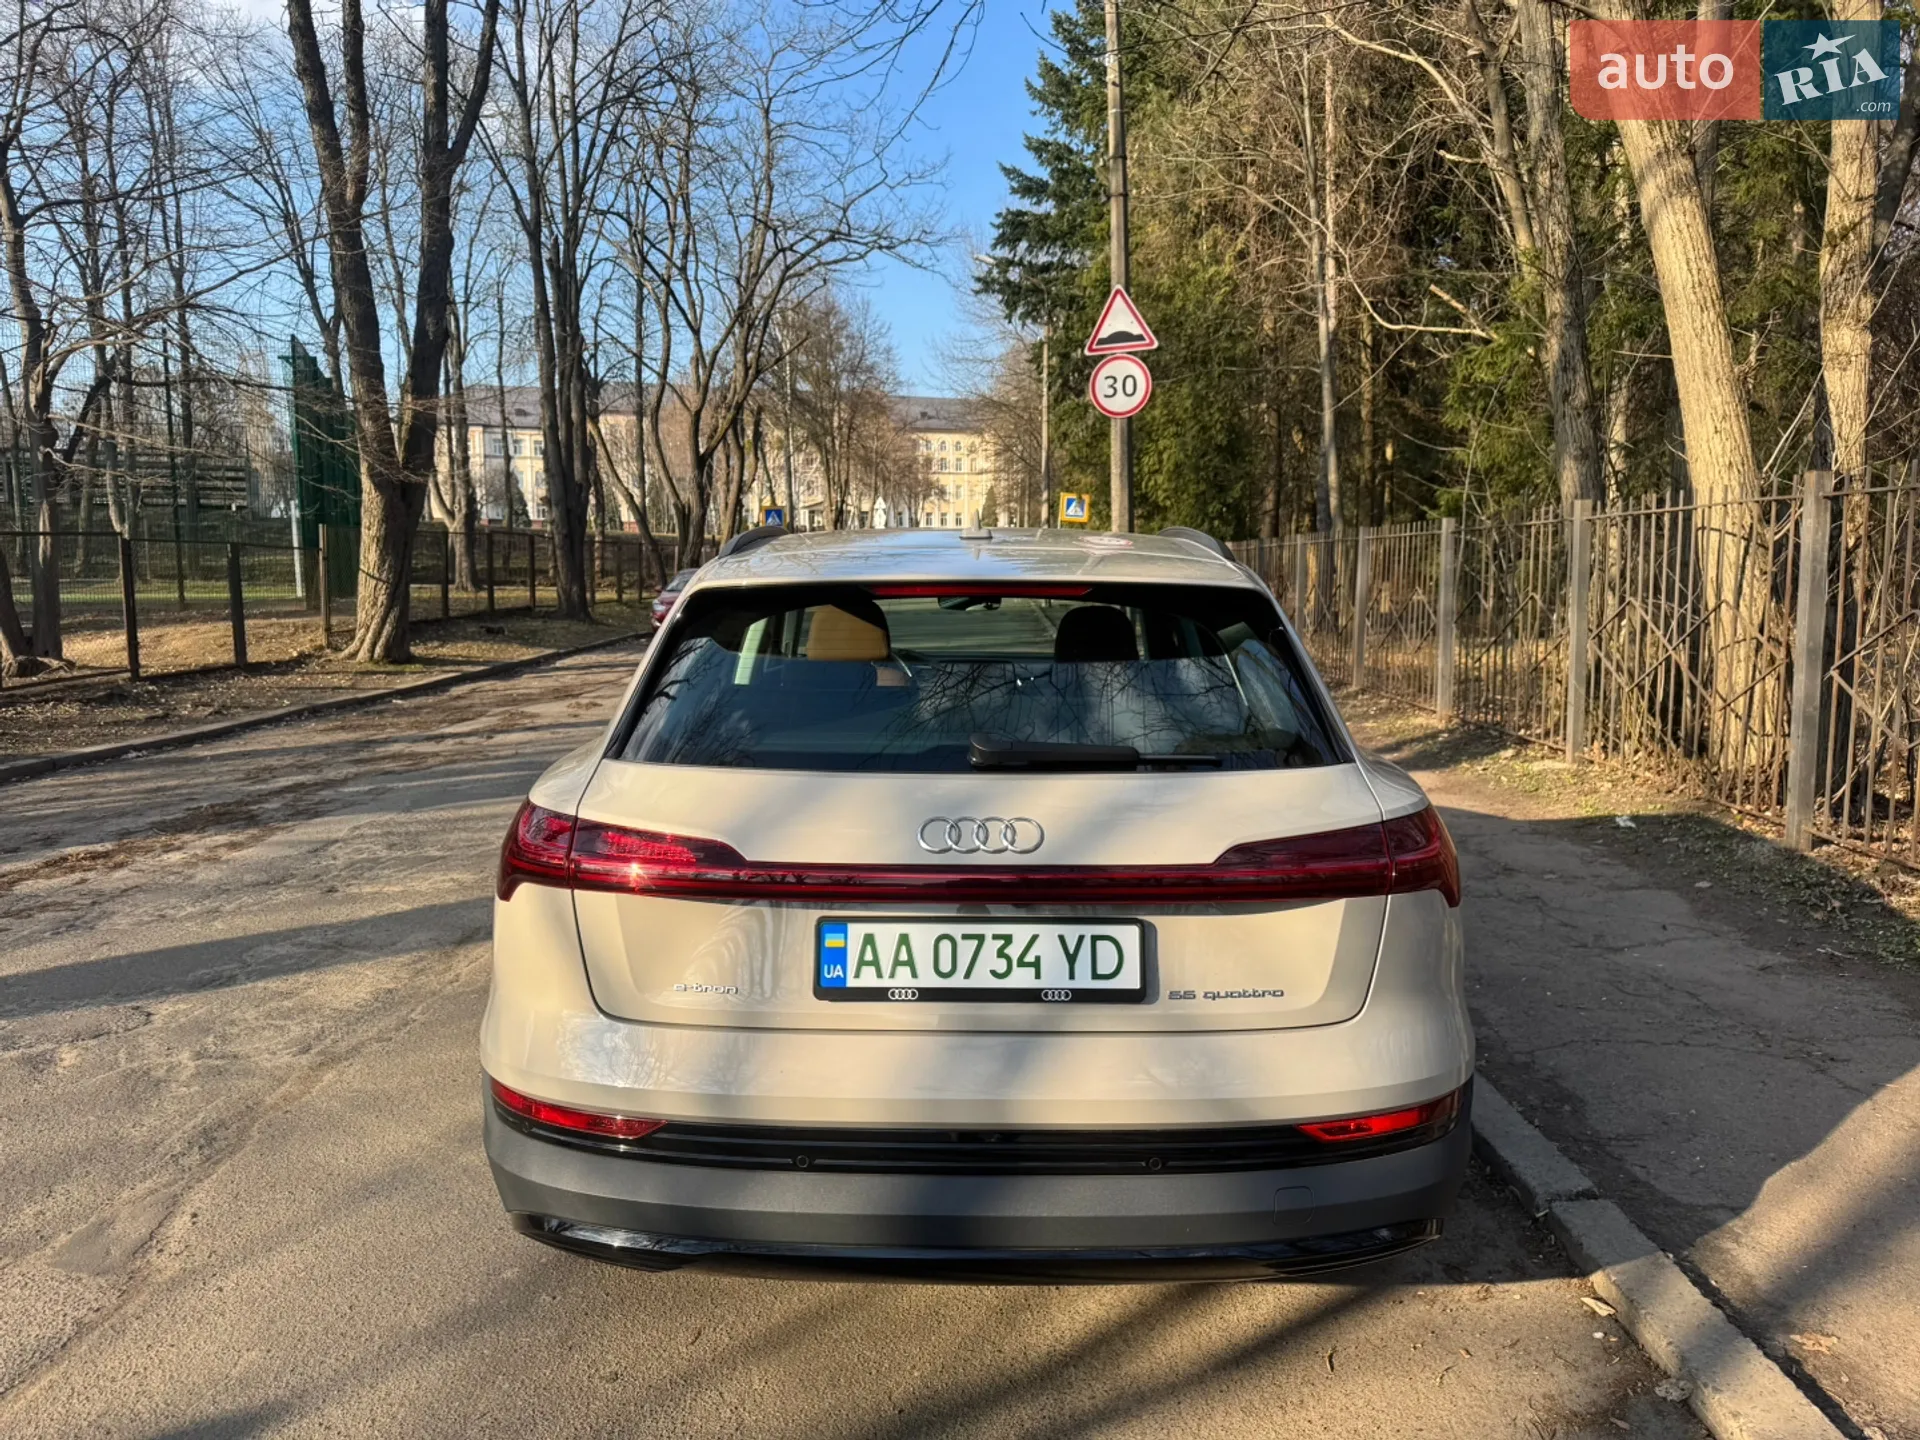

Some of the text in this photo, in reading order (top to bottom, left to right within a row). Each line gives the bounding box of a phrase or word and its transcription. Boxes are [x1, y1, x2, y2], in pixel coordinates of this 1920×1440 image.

[1103, 374, 1137, 399] 30
[853, 933, 1124, 980] AA 0734 YD
[824, 963, 844, 978] UA
[1202, 988, 1284, 1001] quattro
